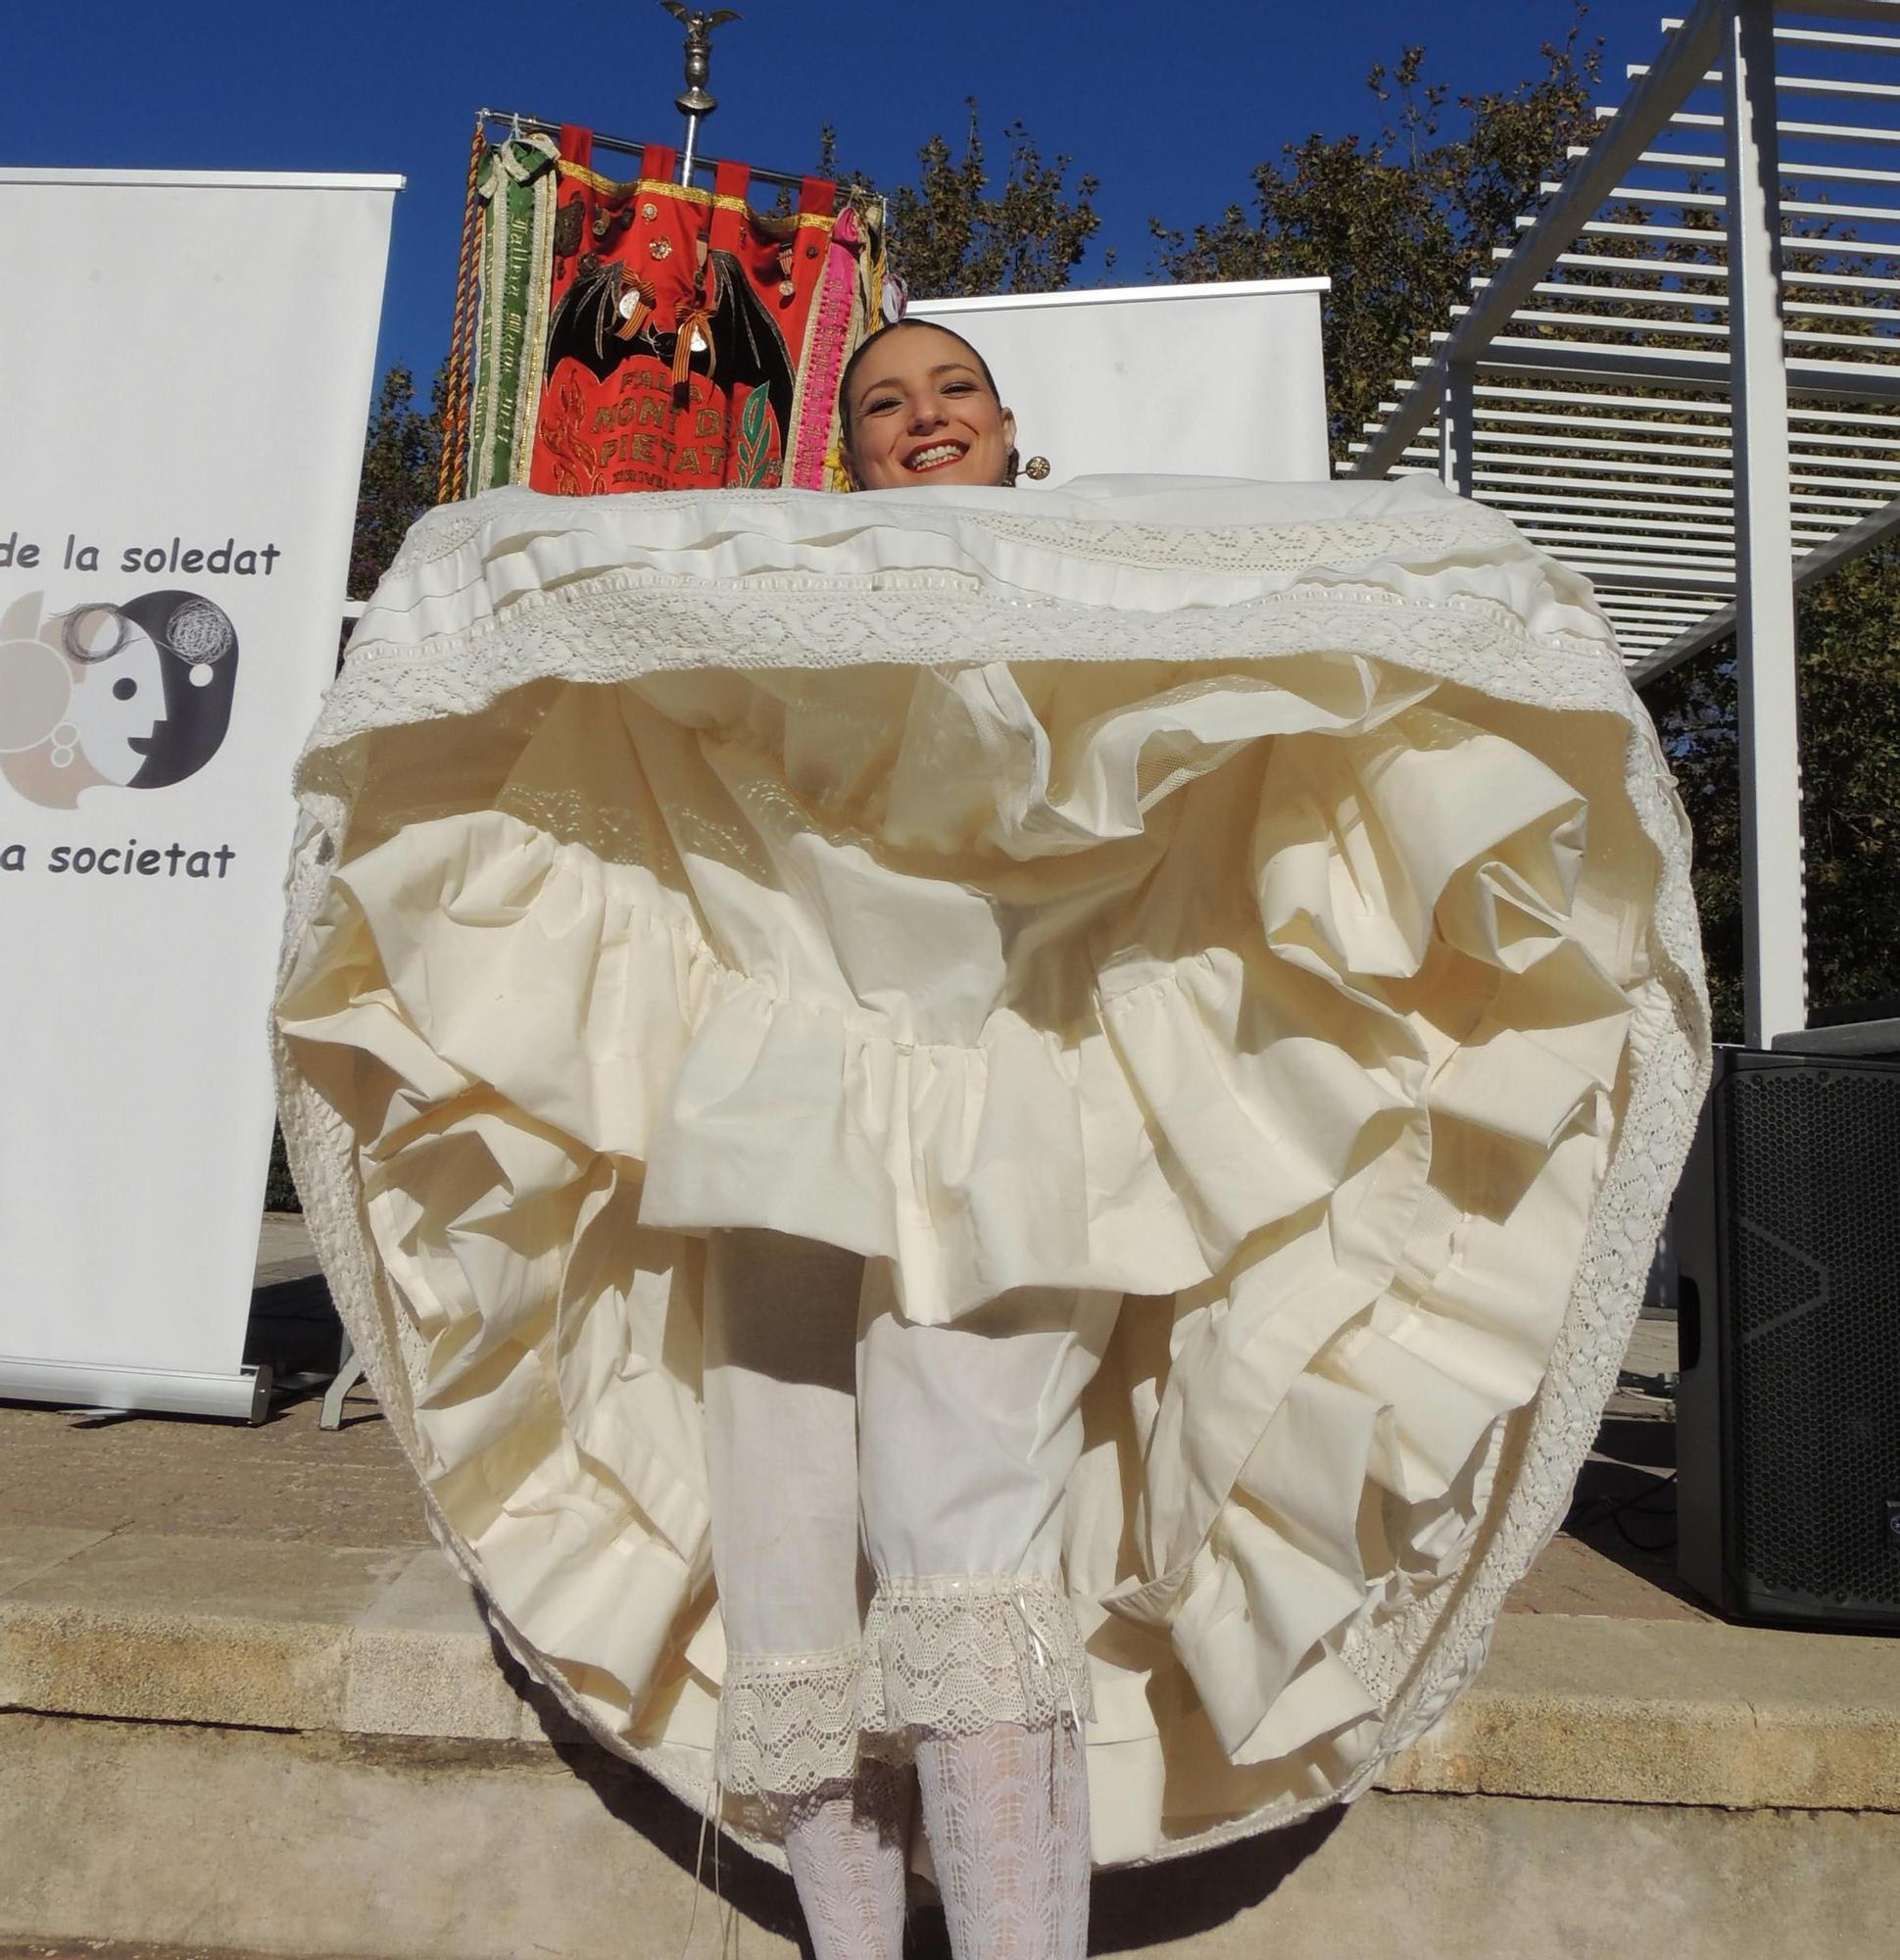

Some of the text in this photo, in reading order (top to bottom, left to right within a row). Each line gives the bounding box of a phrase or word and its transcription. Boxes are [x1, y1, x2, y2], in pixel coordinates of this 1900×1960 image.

[619, 369, 704, 404] FALA
[590, 396, 681, 434] MONT
[598, 432, 728, 476] PIETAT
[0, 531, 281, 575] de la soledat
[47, 838, 236, 879] societat
